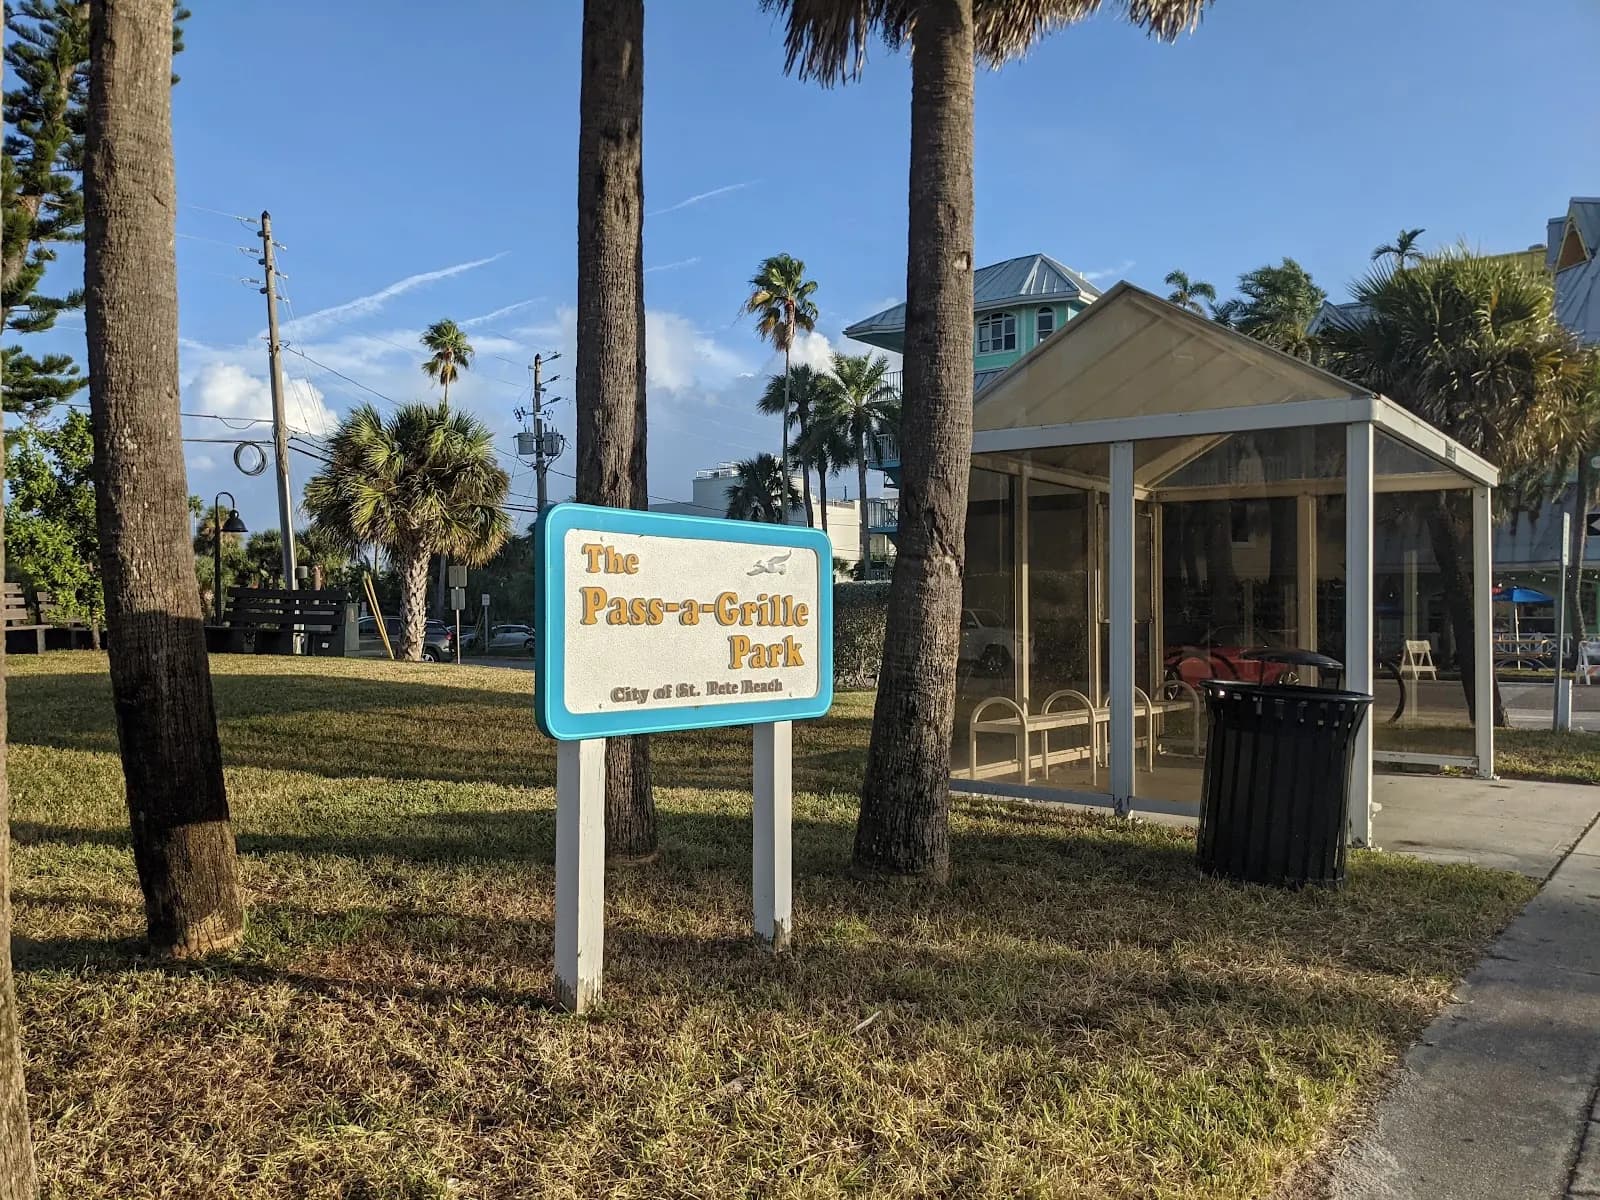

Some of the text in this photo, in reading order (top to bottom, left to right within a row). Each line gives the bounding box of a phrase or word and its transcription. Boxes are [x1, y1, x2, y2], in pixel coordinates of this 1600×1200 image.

[582, 543, 639, 574] The
[580, 586, 809, 627] Pass-a-Grille
[728, 634, 804, 670] Park
[610, 678, 783, 704] City of St. Pete Beach
